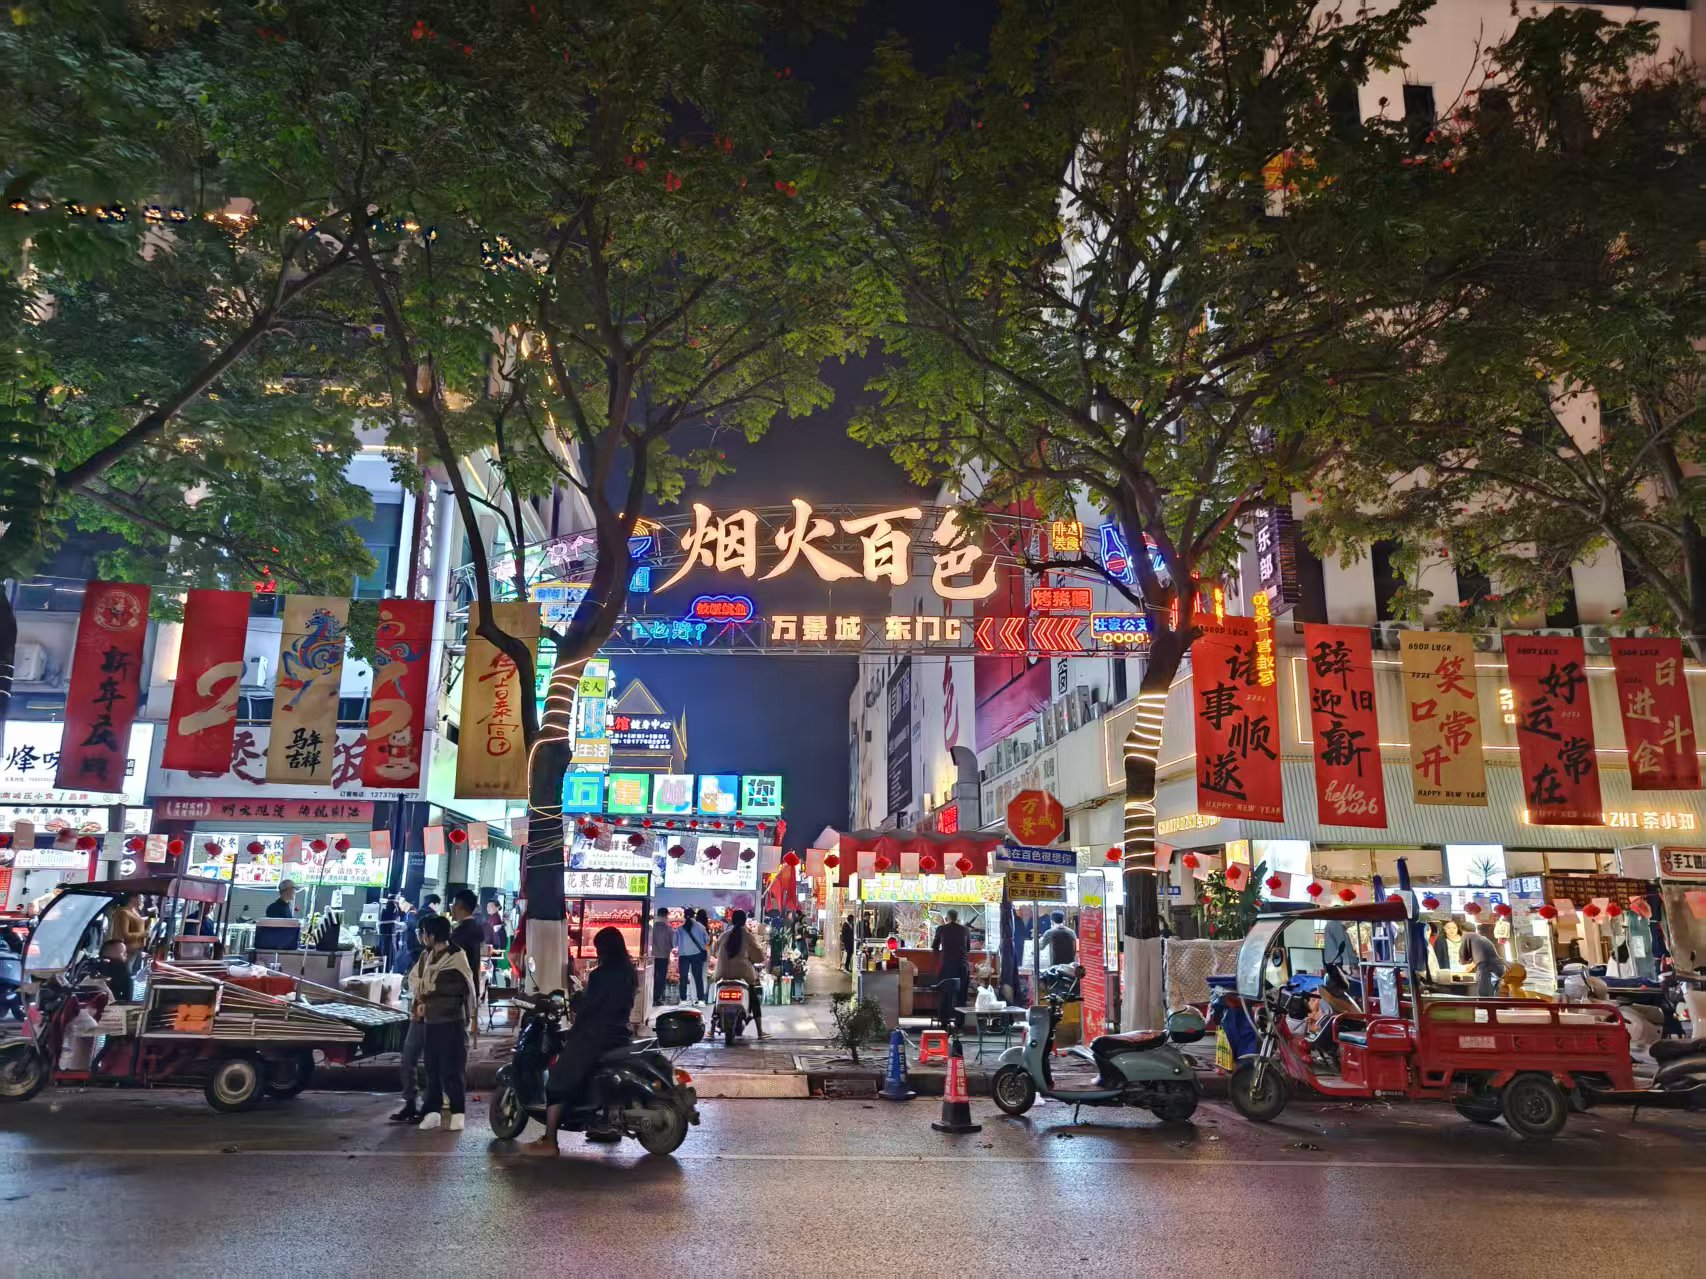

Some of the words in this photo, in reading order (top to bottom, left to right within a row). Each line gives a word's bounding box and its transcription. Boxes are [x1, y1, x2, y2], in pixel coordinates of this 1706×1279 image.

[654, 498, 998, 600] 烟火百色
[771, 616, 861, 641] 万景城
[885, 616, 961, 641] 东门C
[1408, 642, 1429, 650] GOOD
[1431, 643, 1452, 652] LUCK
[1311, 640, 1374, 778] 辞旧迎新
[1626, 656, 1692, 775] 日进斗金
[1410, 655, 1477, 787] 笑口常开
[1520, 661, 1594, 807] 好运常在
[1324, 780, 1365, 802] hello
[1417, 789, 1441, 797] HAPPY
[1466, 791, 1487, 799] YEAR
[1237, 804, 1255, 812] NEW
[1333, 797, 1378, 815] 2026
[1642, 812, 1695, 830] 茶小知
